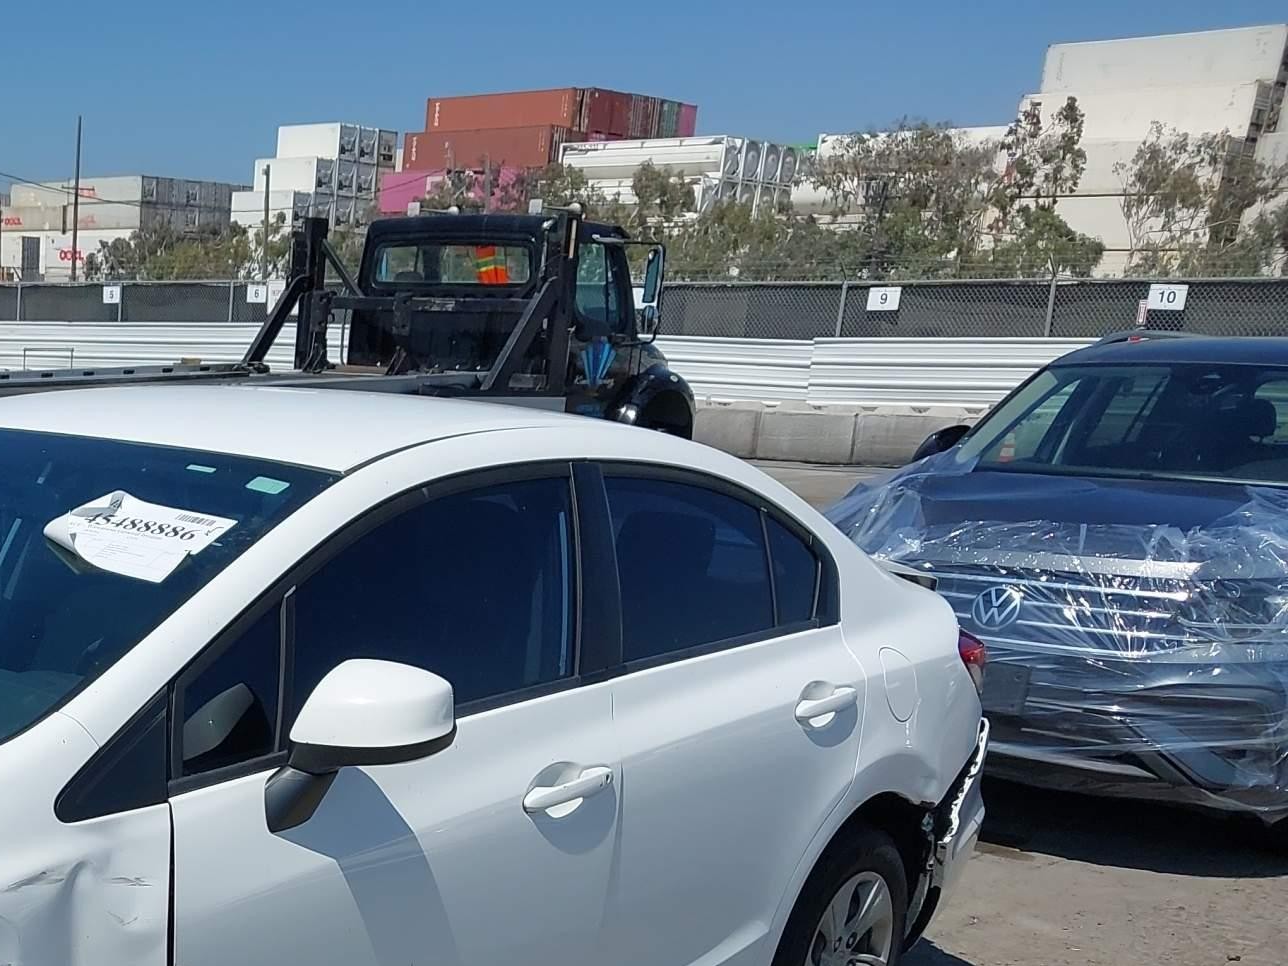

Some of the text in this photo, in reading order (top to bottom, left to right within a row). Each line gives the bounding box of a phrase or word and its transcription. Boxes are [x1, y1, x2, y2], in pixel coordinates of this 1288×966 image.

[254, 288, 260, 299] 6
[879, 292, 888, 305] 9
[1158, 290, 1177, 304] 10
[84, 512, 200, 542] 45488886
